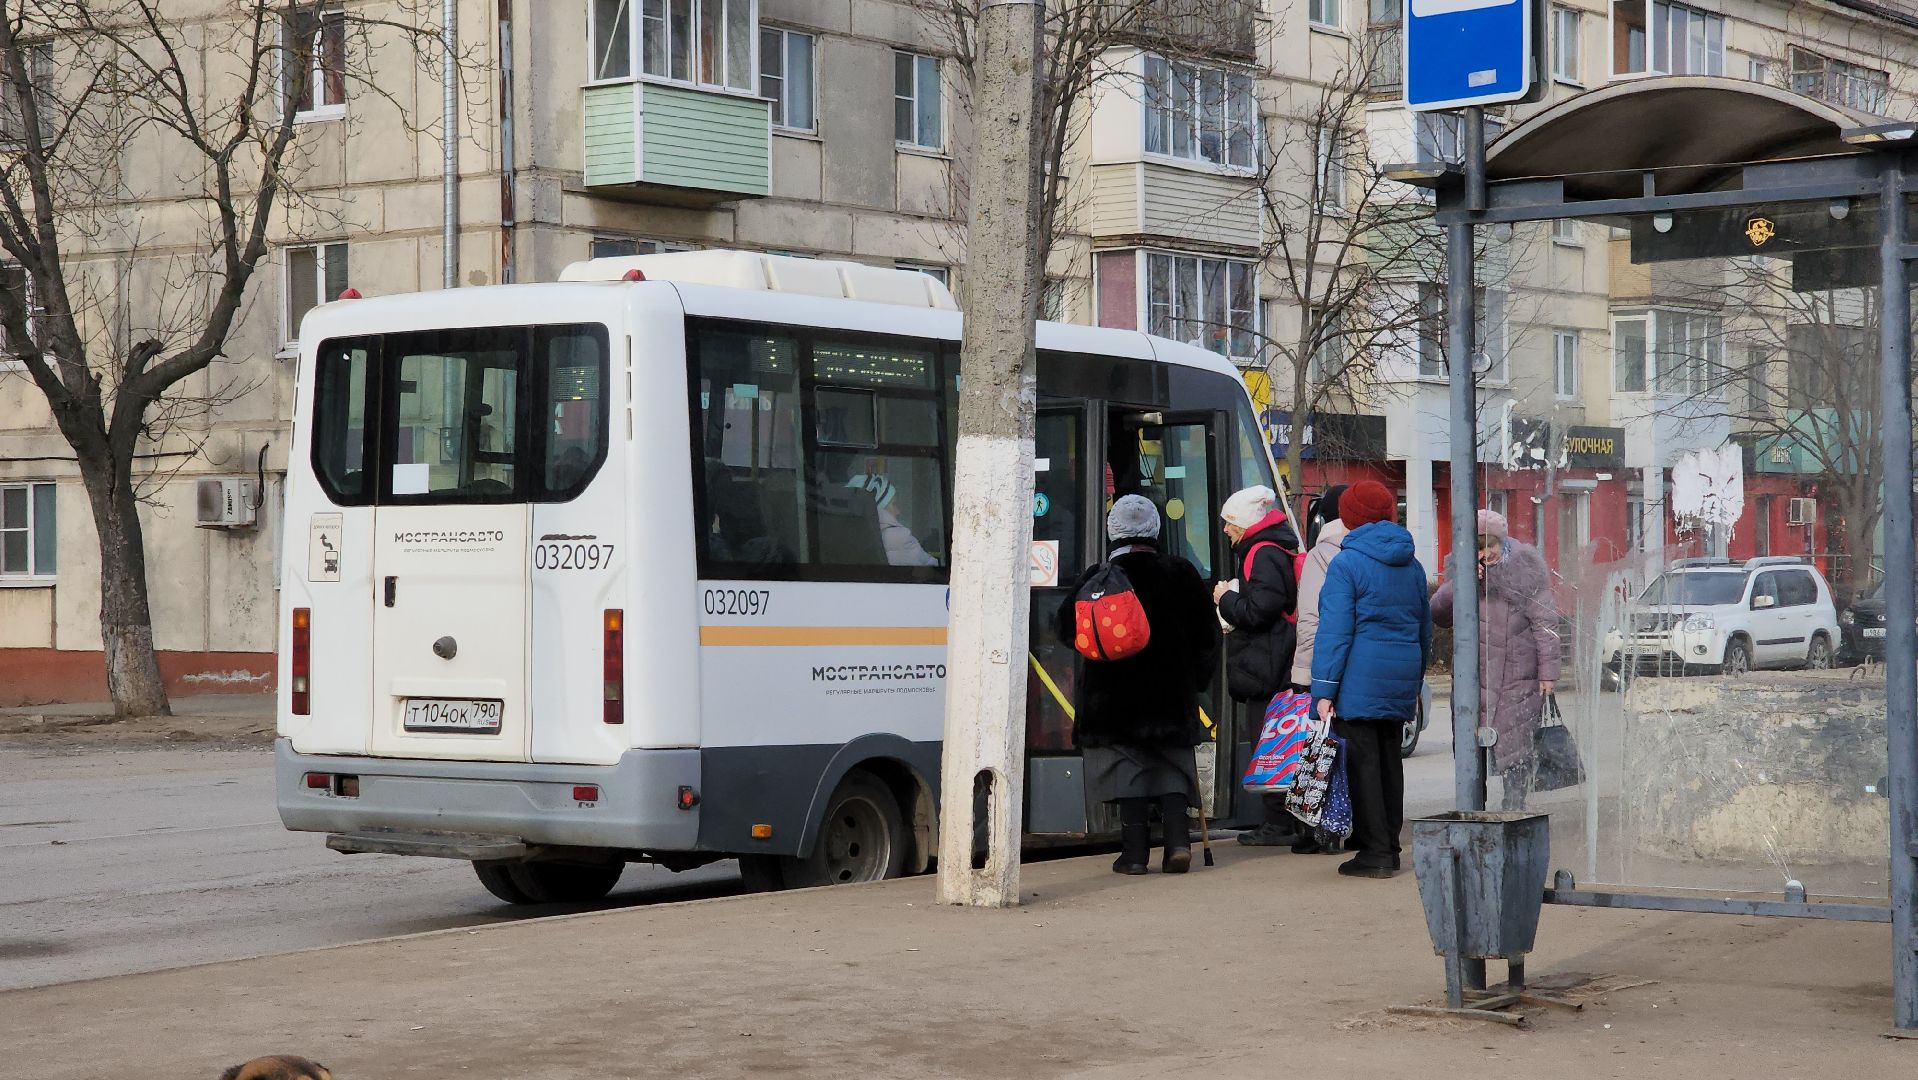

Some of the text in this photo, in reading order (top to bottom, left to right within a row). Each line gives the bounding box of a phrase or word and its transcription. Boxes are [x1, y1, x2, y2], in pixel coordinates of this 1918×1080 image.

[394, 530, 504, 543] МОСТРАНСАВТО
[535, 544, 615, 570] 032097
[704, 589, 770, 615] 032097
[812, 664, 947, 681] МОСТРАНСАВТО
[473, 703, 496, 719] 790
